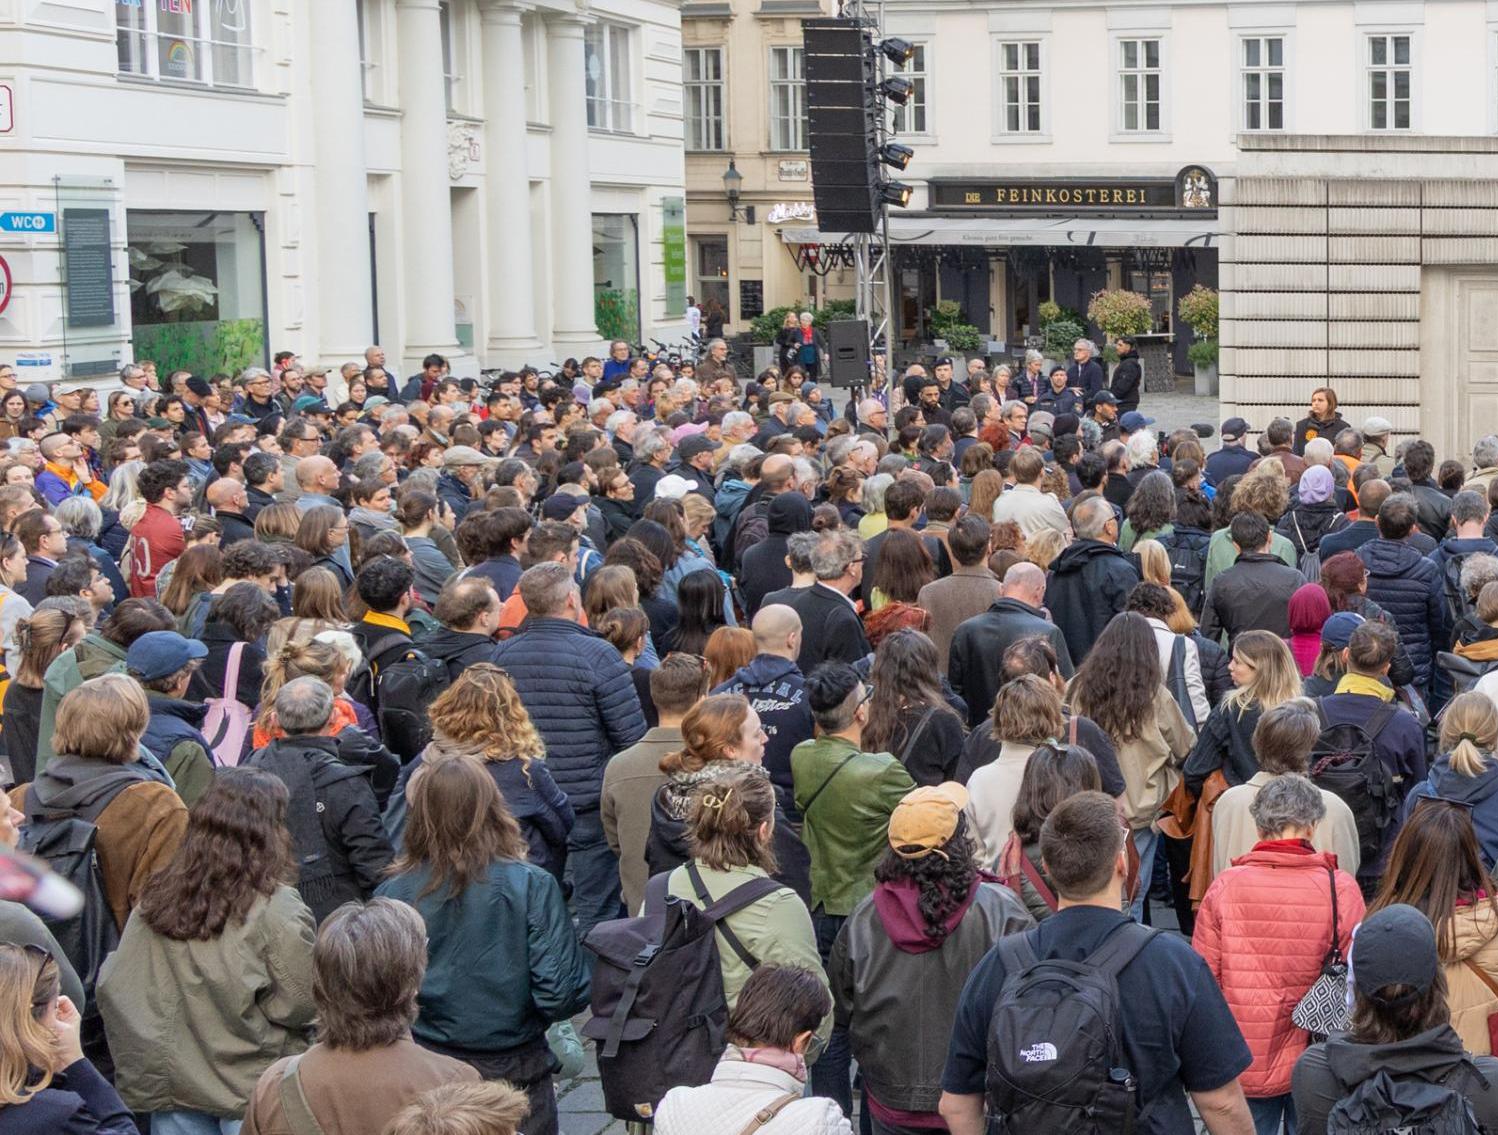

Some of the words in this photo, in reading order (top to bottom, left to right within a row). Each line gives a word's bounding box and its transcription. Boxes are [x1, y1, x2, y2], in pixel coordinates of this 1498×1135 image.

[966, 192, 981, 203] DIE
[996, 188, 1147, 204] FEINKOSTEREI
[11, 215, 33, 229] WC
[1020, 1049, 1045, 1057] NORTH
